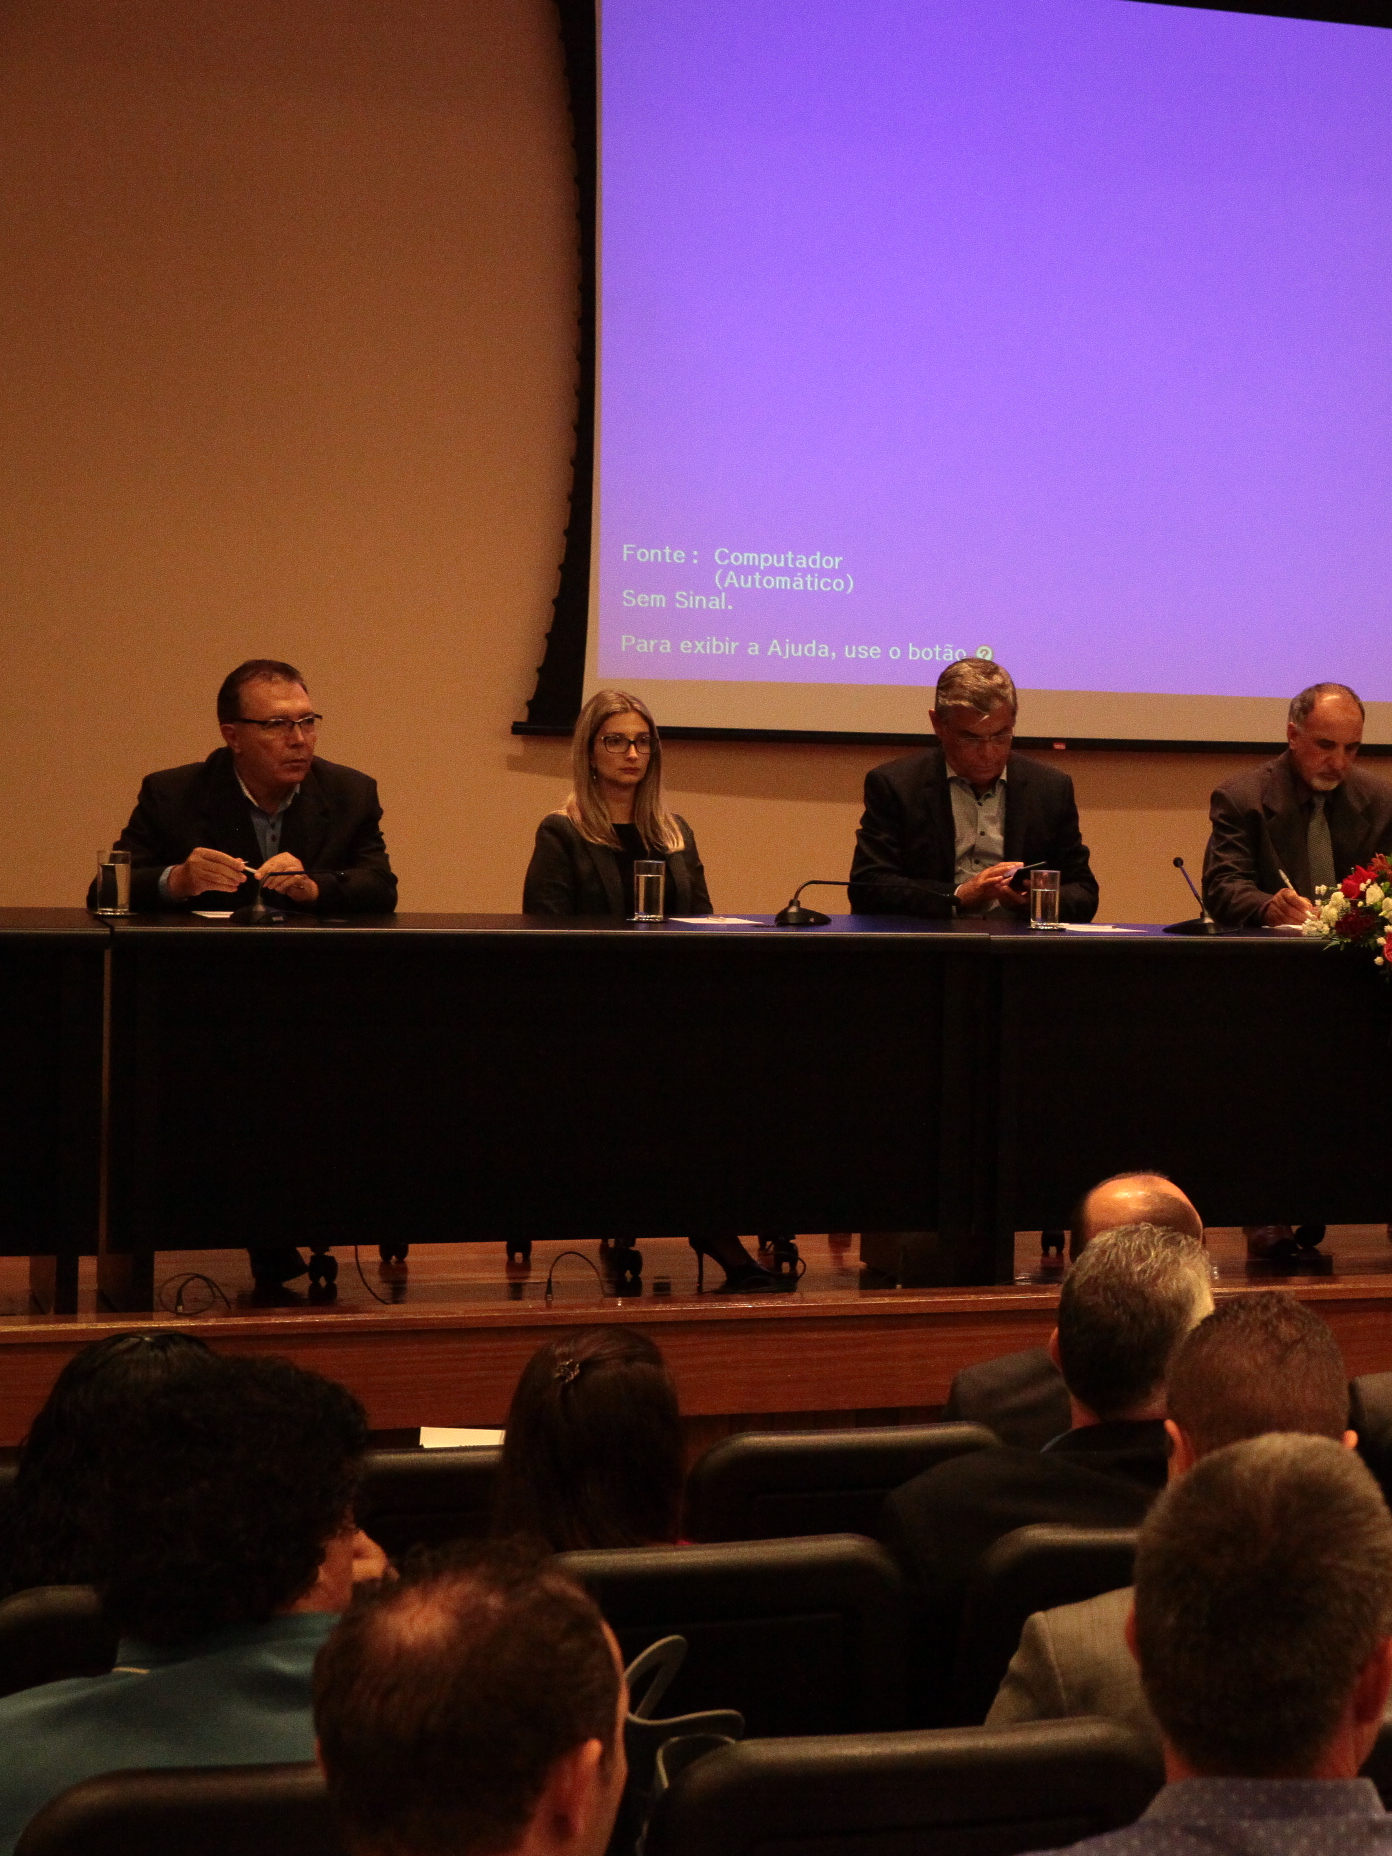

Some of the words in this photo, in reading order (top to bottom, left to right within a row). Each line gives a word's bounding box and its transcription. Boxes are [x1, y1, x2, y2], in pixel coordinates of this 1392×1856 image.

[714, 548, 844, 570] Computador
[714, 569, 854, 595] (Automático)
[622, 589, 667, 608] Sem
[675, 590, 734, 610] Sinal.
[621, 635, 672, 653] Para
[679, 636, 740, 655] exibir
[747, 642, 760, 656] a
[767, 639, 837, 660] Ajuda,
[844, 644, 882, 659] use
[889, 646, 901, 660] o
[908, 642, 967, 661] botão
